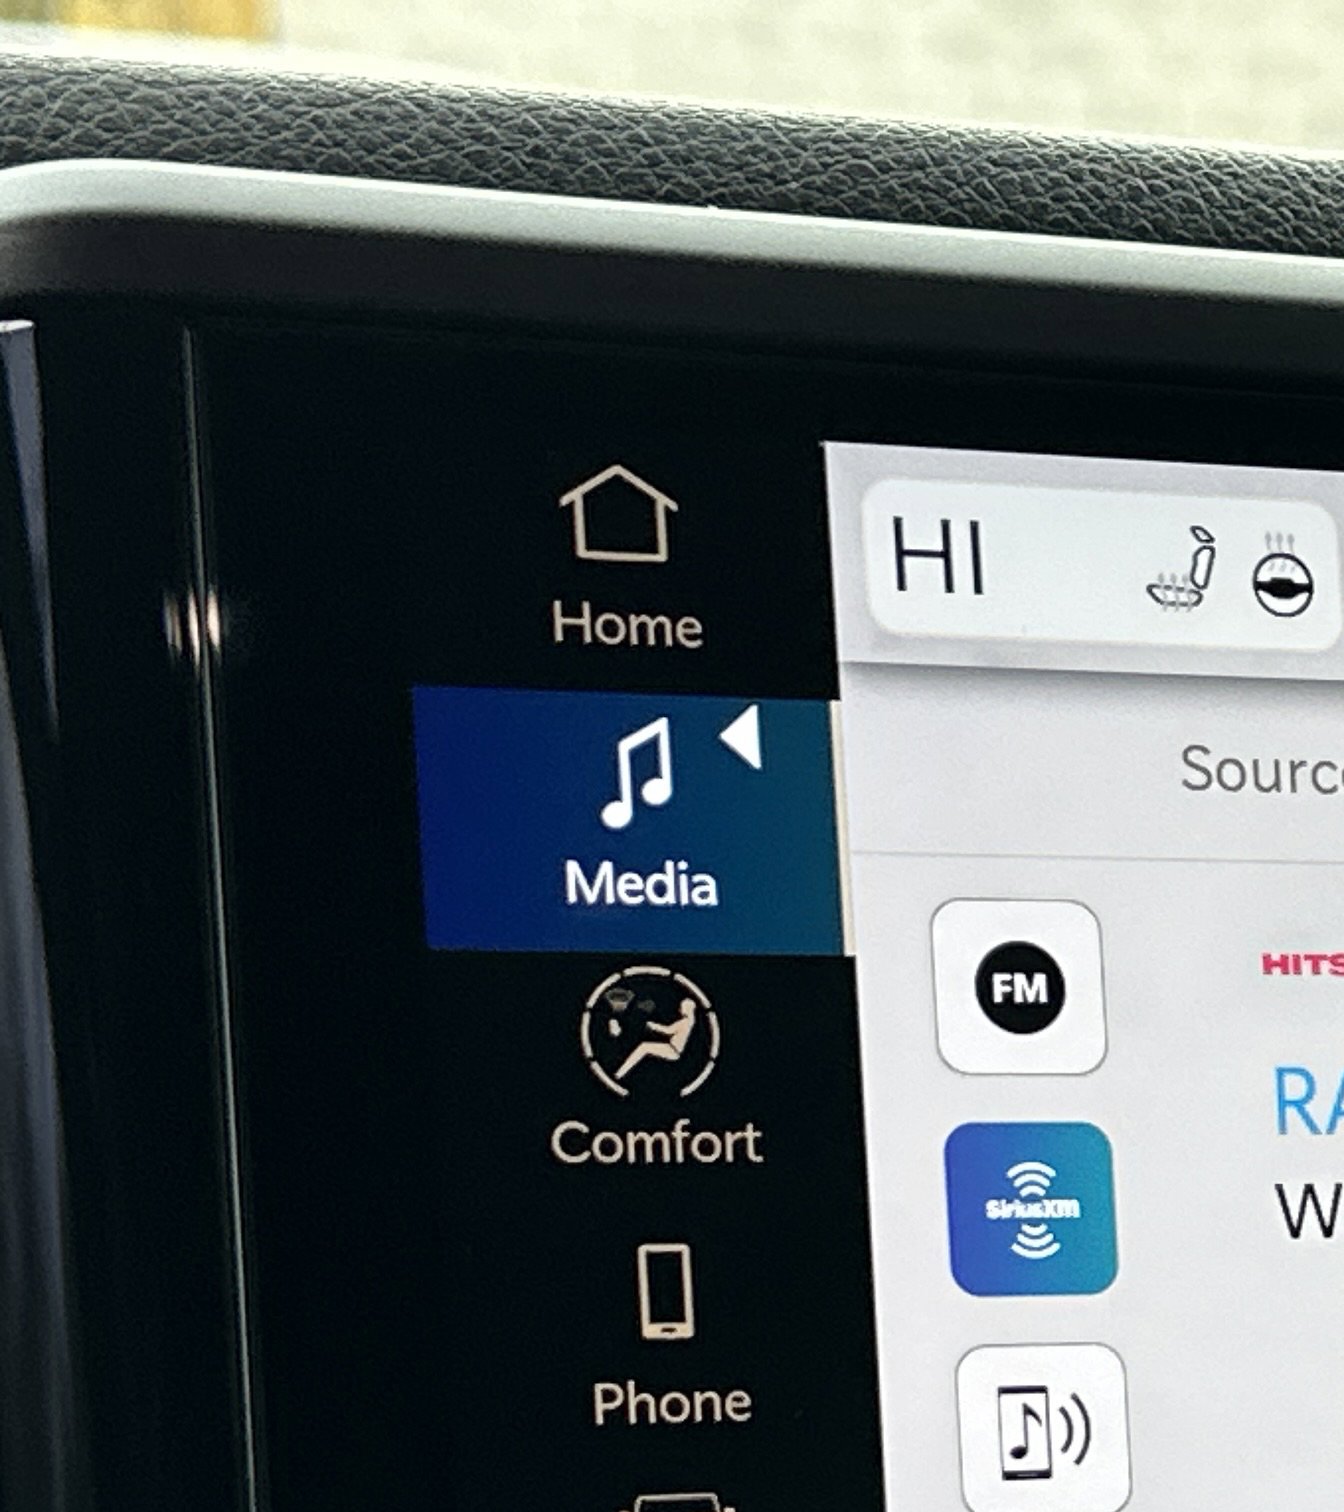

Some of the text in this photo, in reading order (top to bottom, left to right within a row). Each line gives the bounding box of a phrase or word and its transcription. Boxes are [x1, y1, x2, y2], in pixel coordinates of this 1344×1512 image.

[892, 515, 983, 596] HI
[552, 600, 703, 649] Home
[565, 859, 718, 906] Media
[992, 972, 1048, 1003] FM
[551, 1118, 764, 1164] Comfort
[594, 1379, 752, 1426] Phone
